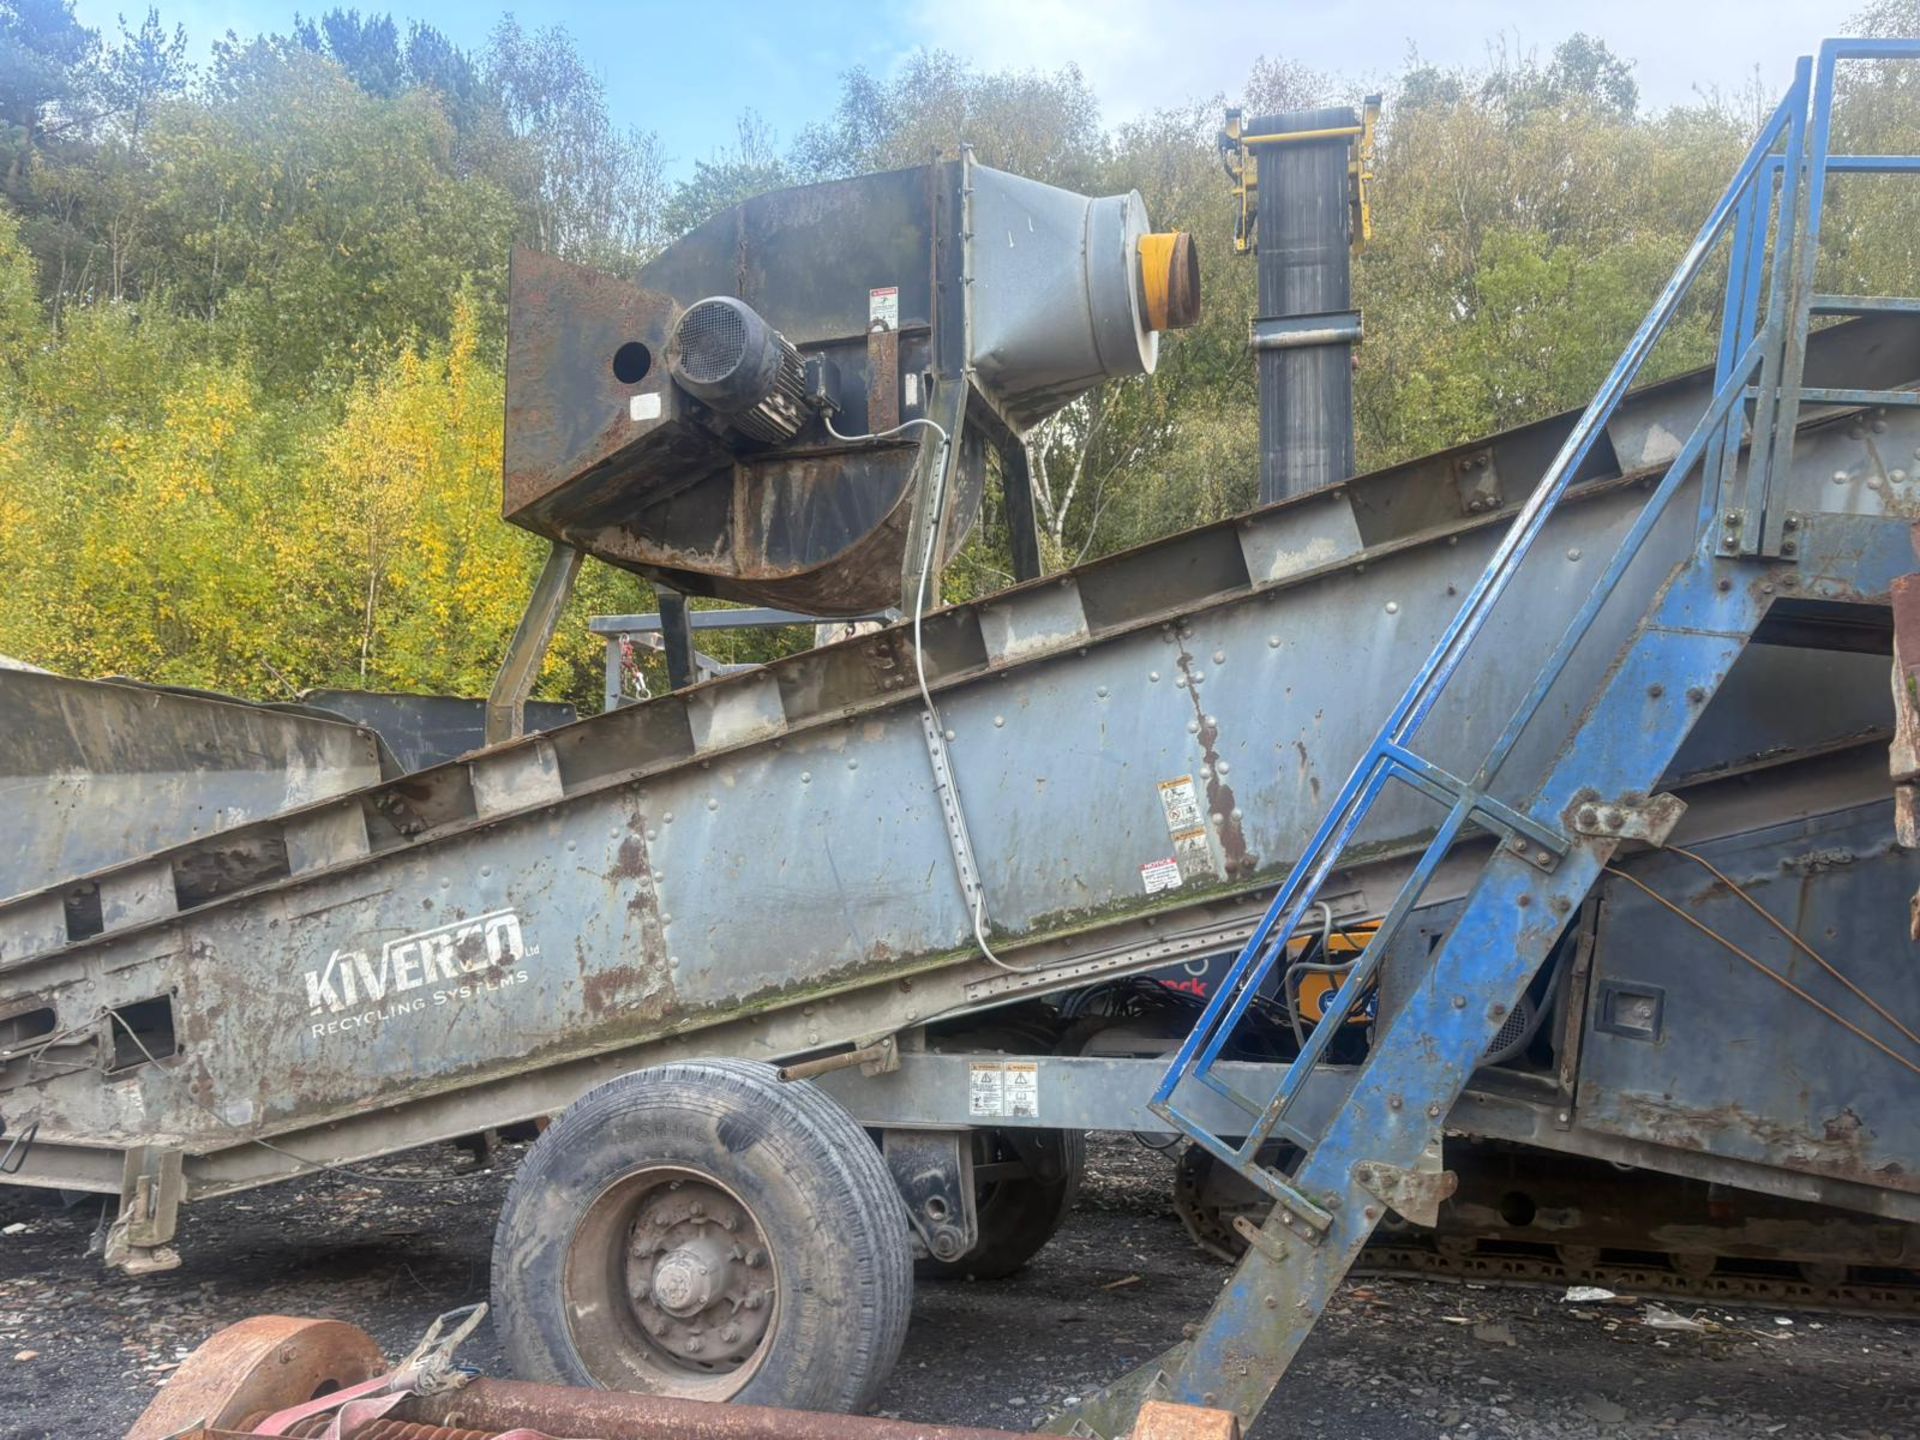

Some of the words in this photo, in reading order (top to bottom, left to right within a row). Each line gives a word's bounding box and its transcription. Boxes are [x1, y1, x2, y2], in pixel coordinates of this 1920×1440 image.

[304, 907, 524, 1016] KIVERCO
[524, 943, 540, 957] Ltd
[311, 999, 426, 1039] RECYCLING
